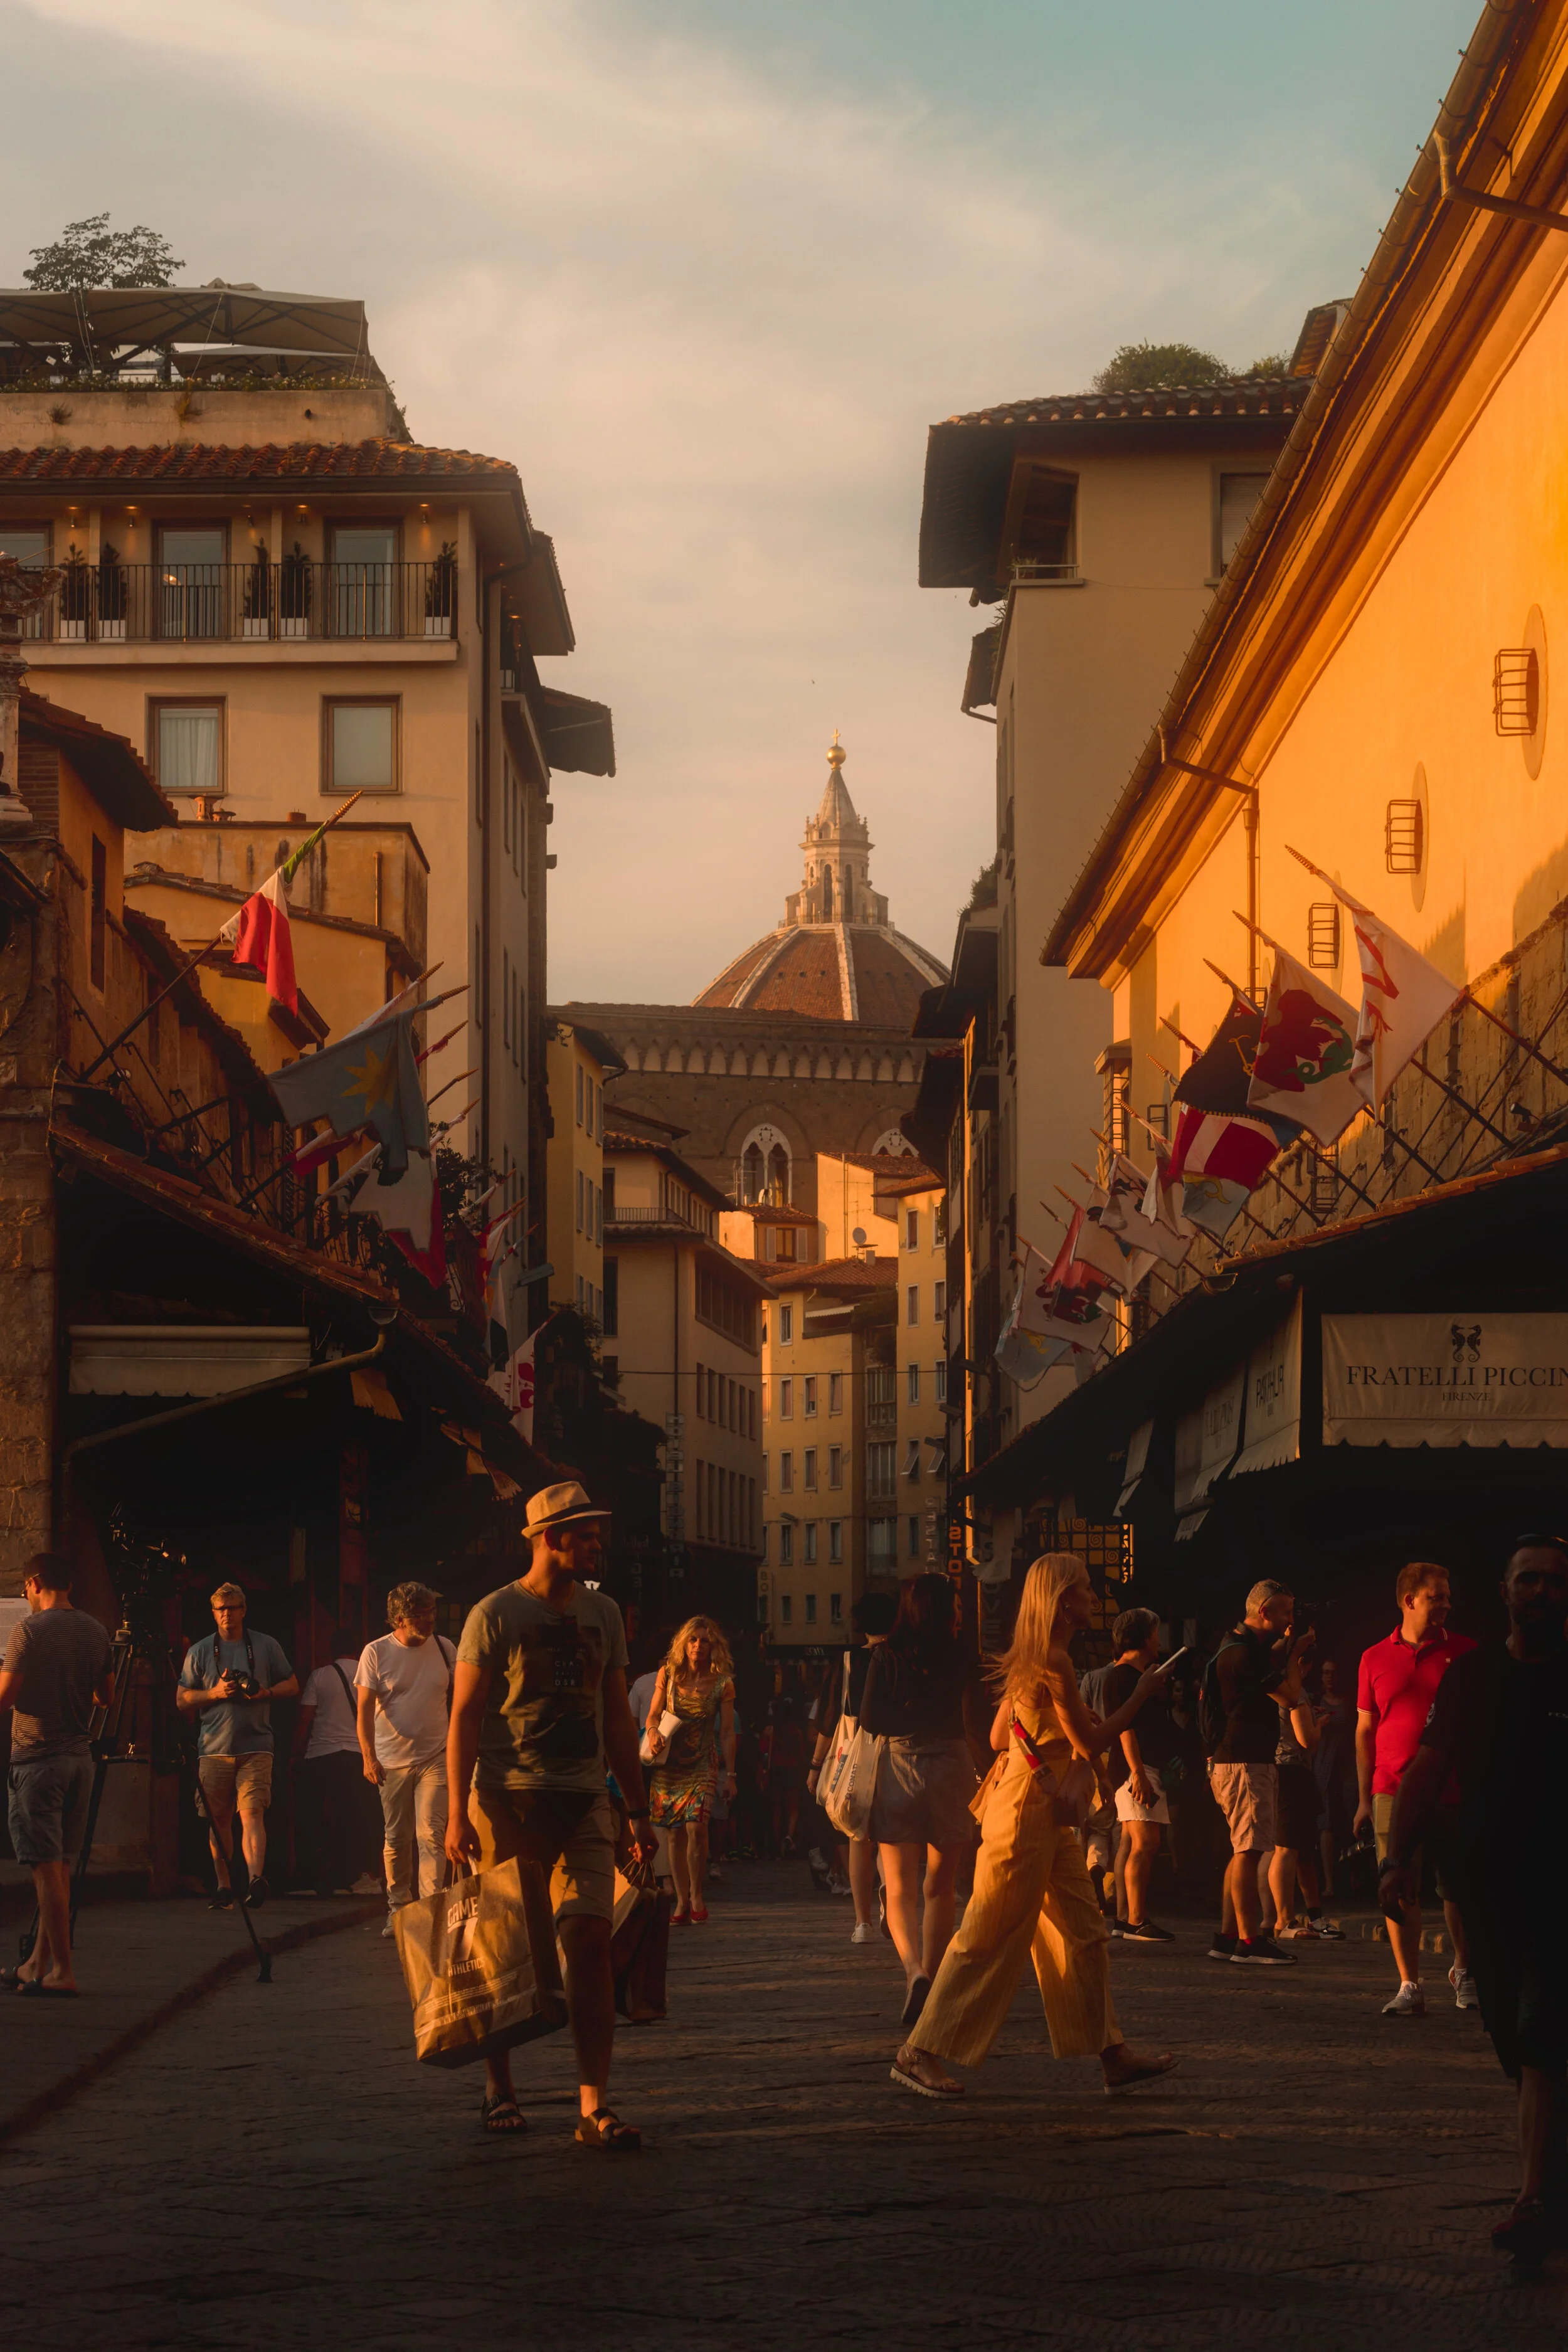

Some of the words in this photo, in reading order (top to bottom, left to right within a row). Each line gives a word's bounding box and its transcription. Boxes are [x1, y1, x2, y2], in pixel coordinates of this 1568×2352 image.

[1346, 1365, 1476, 1386] FRATELLI
[1442, 1392, 1491, 1402] FIRENZE
[447, 1896, 479, 1928] GAME
[447, 1916, 479, 1961] 7
